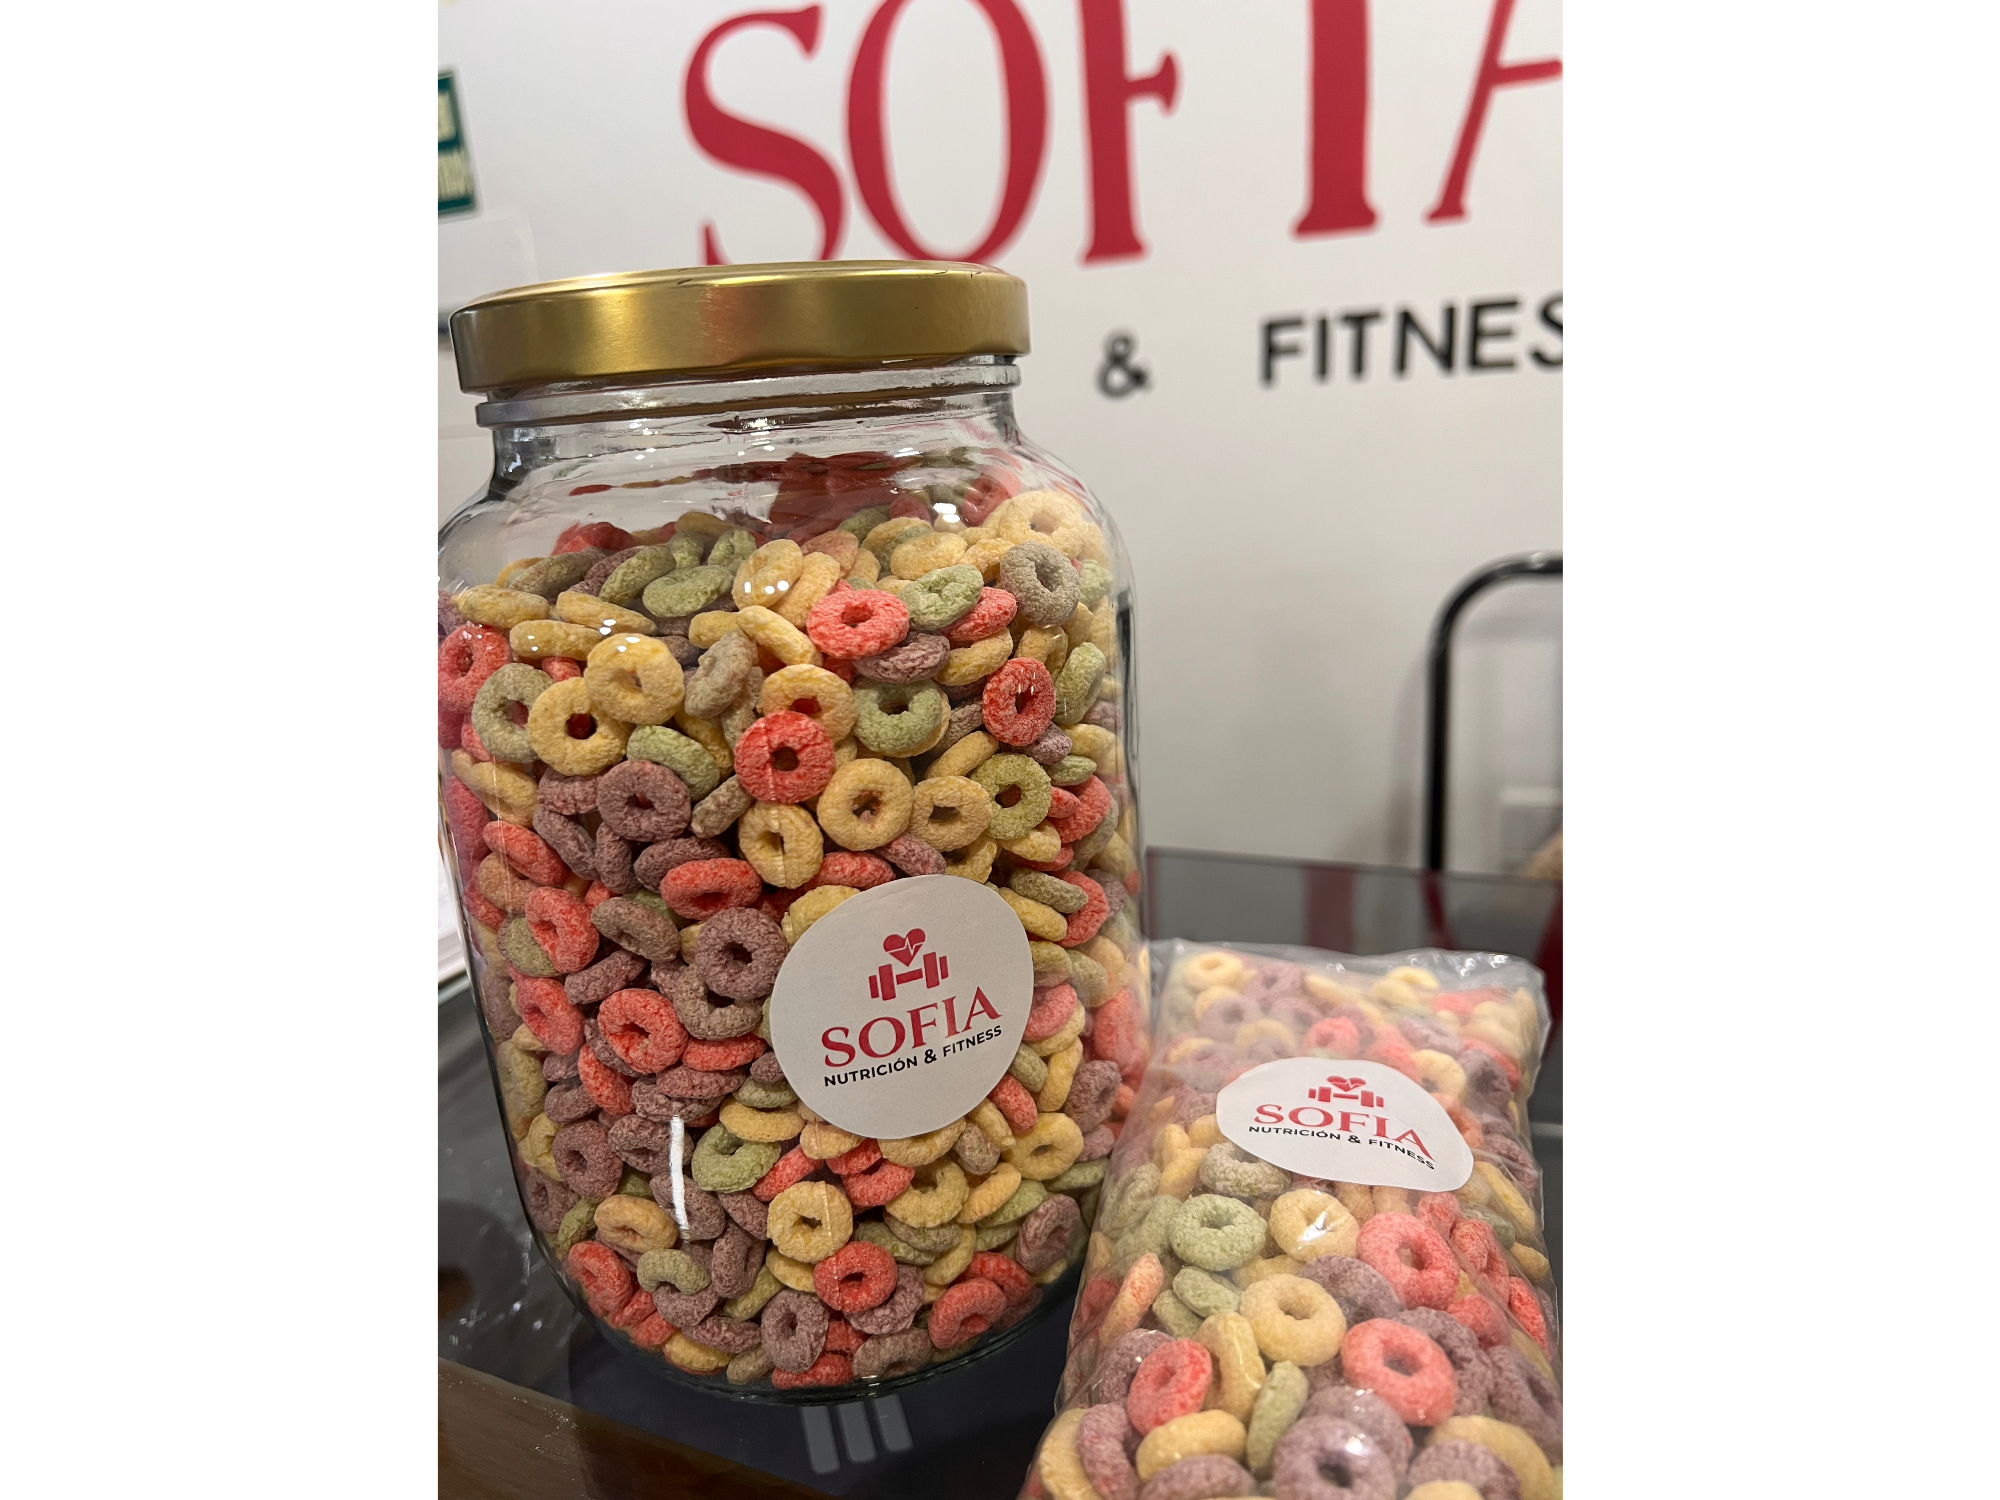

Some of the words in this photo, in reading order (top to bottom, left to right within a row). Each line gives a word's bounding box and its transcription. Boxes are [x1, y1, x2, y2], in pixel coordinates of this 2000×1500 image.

[1097, 329, 1153, 400] &
[821, 986, 1003, 1068] SOFIA
[824, 1056, 918, 1086] NUTRICIÓN
[924, 1049, 937, 1065] &
[943, 1025, 1003, 1057] FITNESS
[1249, 1126, 1340, 1140] NUTRICIÓN
[1347, 1134, 1361, 1144] &
[1369, 1139, 1435, 1169] FITNESS
[1254, 1104, 1434, 1160] SOFIA
